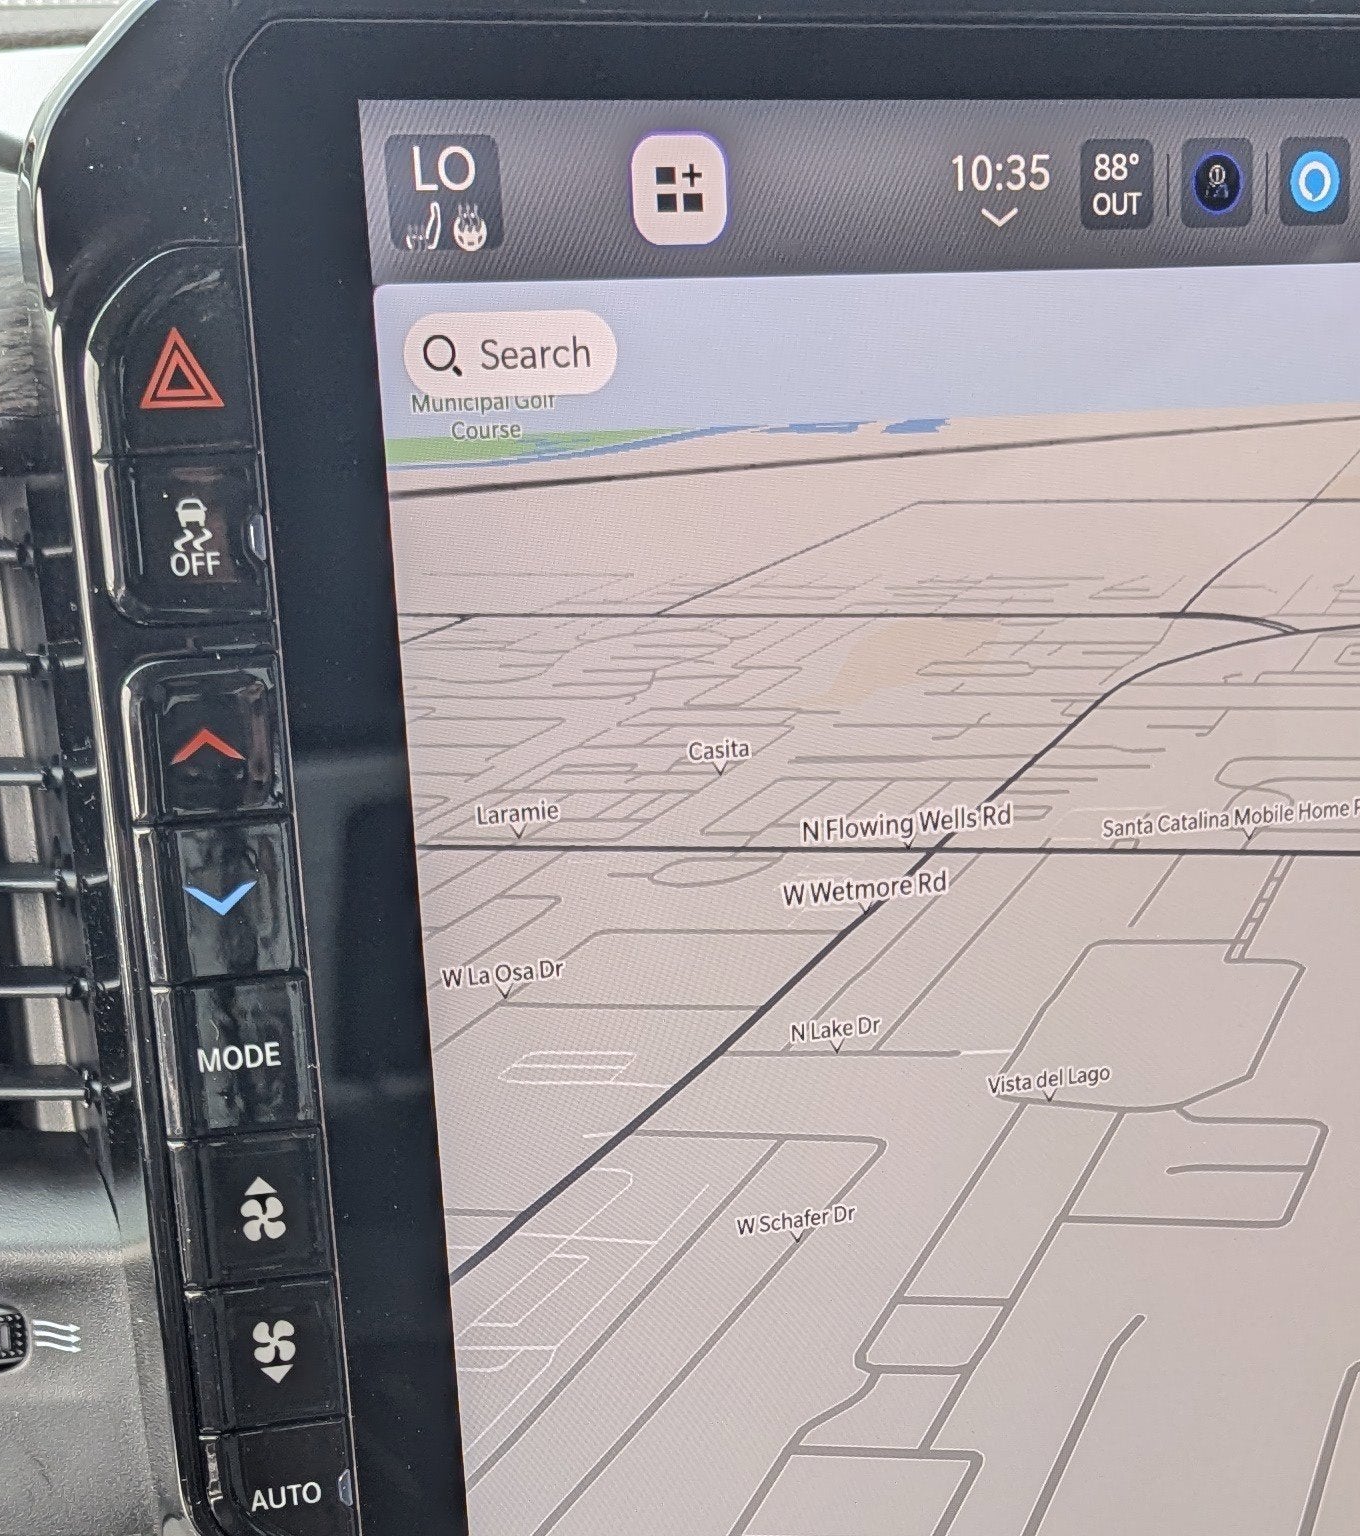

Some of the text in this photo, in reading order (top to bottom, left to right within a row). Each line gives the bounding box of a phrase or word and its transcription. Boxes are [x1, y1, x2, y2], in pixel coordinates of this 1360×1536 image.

[412, 145, 476, 192] LO
[952, 153, 1051, 193] 10:35
[1092, 152, 1140, 182] 88°
[1092, 191, 1142, 218] OUT
[479, 335, 592, 372] Search
[411, 393, 510, 415] Municipal
[450, 420, 522, 441] Course
[169, 550, 221, 577] OFF
[687, 740, 751, 762] Casita
[475, 801, 560, 826] Laramie
[802, 803, 1012, 843] N Flowing Wells Rd
[1102, 818, 1154, 839] Santa
[1157, 811, 1230, 834] Catalina
[1234, 805, 1294, 828] Mobile
[1298, 801, 1349, 822] Home
[782, 870, 948, 906] W Wetmore Rd
[441, 960, 565, 988] W La Osa Dr
[790, 1016, 881, 1042] N Lake Dr
[196, 1041, 282, 1074] MODE
[988, 1065, 1111, 1095] Vista del Lago
[736, 1205, 857, 1237] W Schafer Dr
[250, 1480, 322, 1512] AUTO
